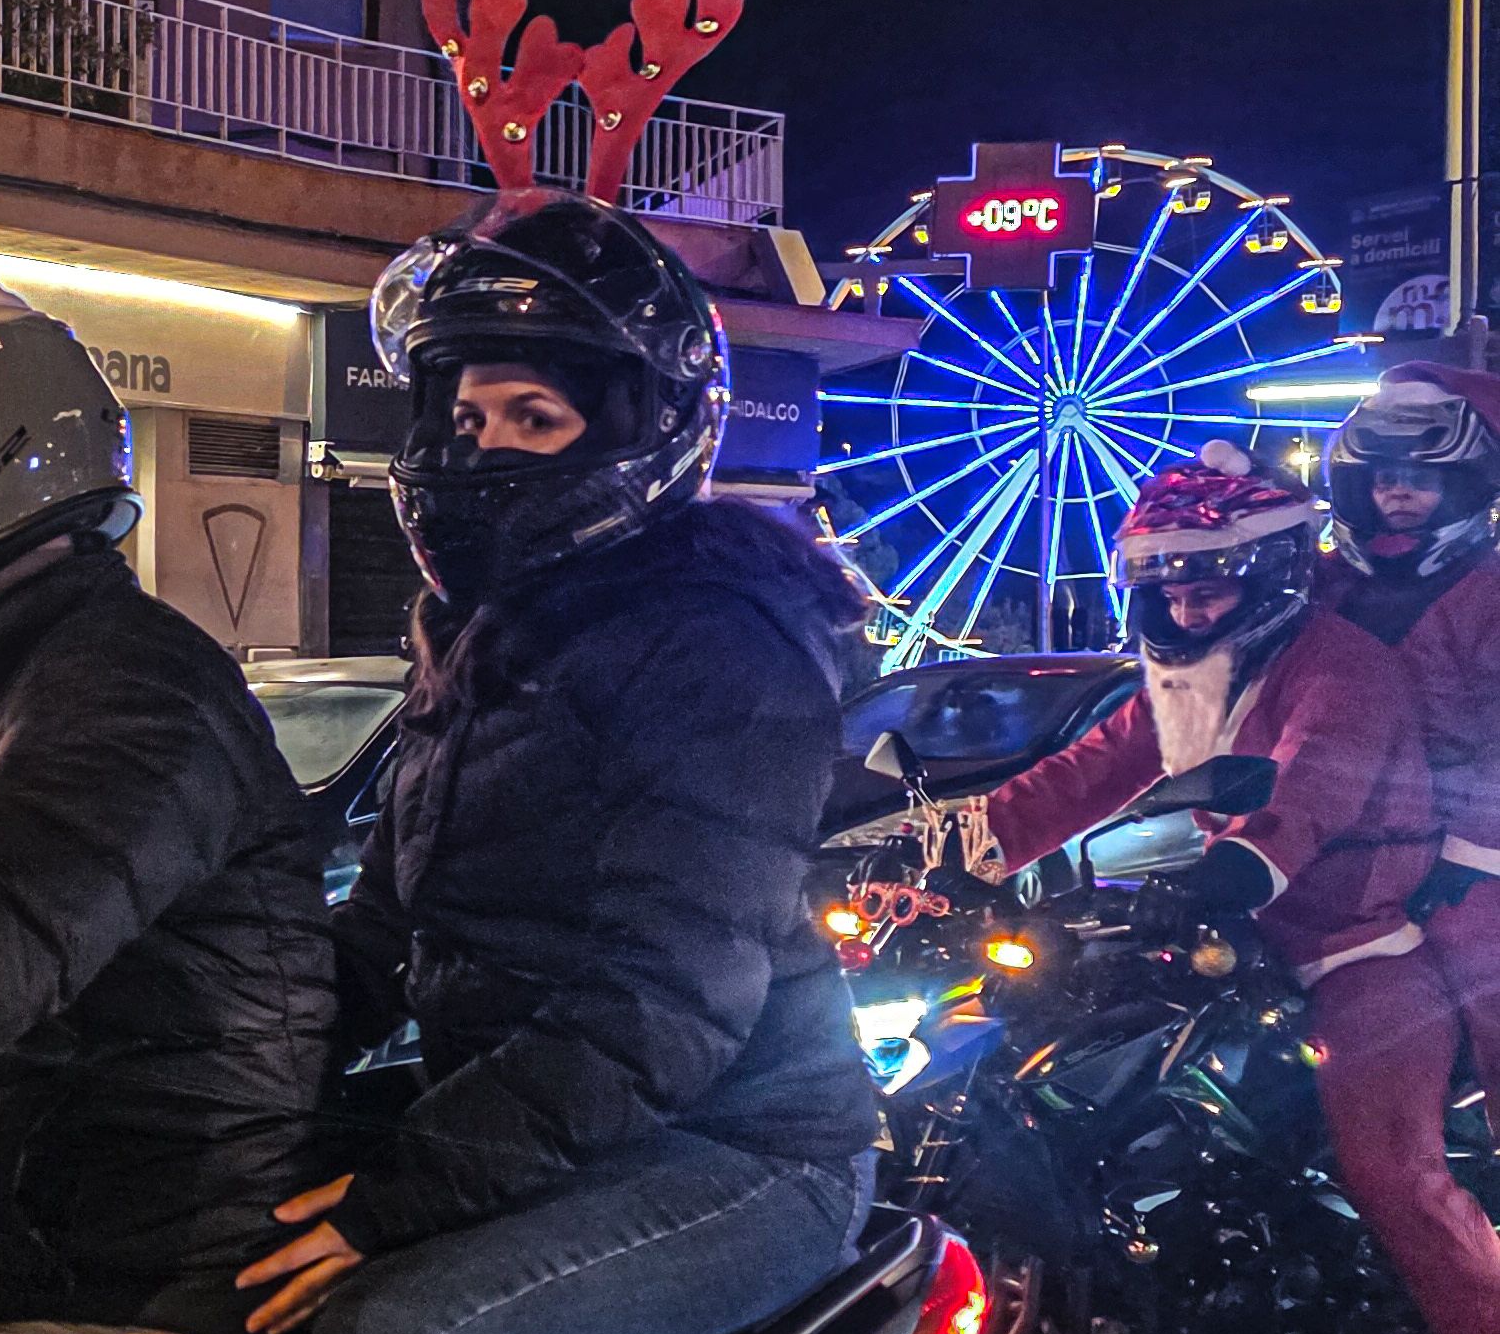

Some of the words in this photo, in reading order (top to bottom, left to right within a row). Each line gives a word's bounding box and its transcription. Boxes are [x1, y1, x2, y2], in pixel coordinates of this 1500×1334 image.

[1350, 226, 1409, 251] Servei
[1350, 253, 1360, 266] a
[1363, 237, 1442, 264] domicili
